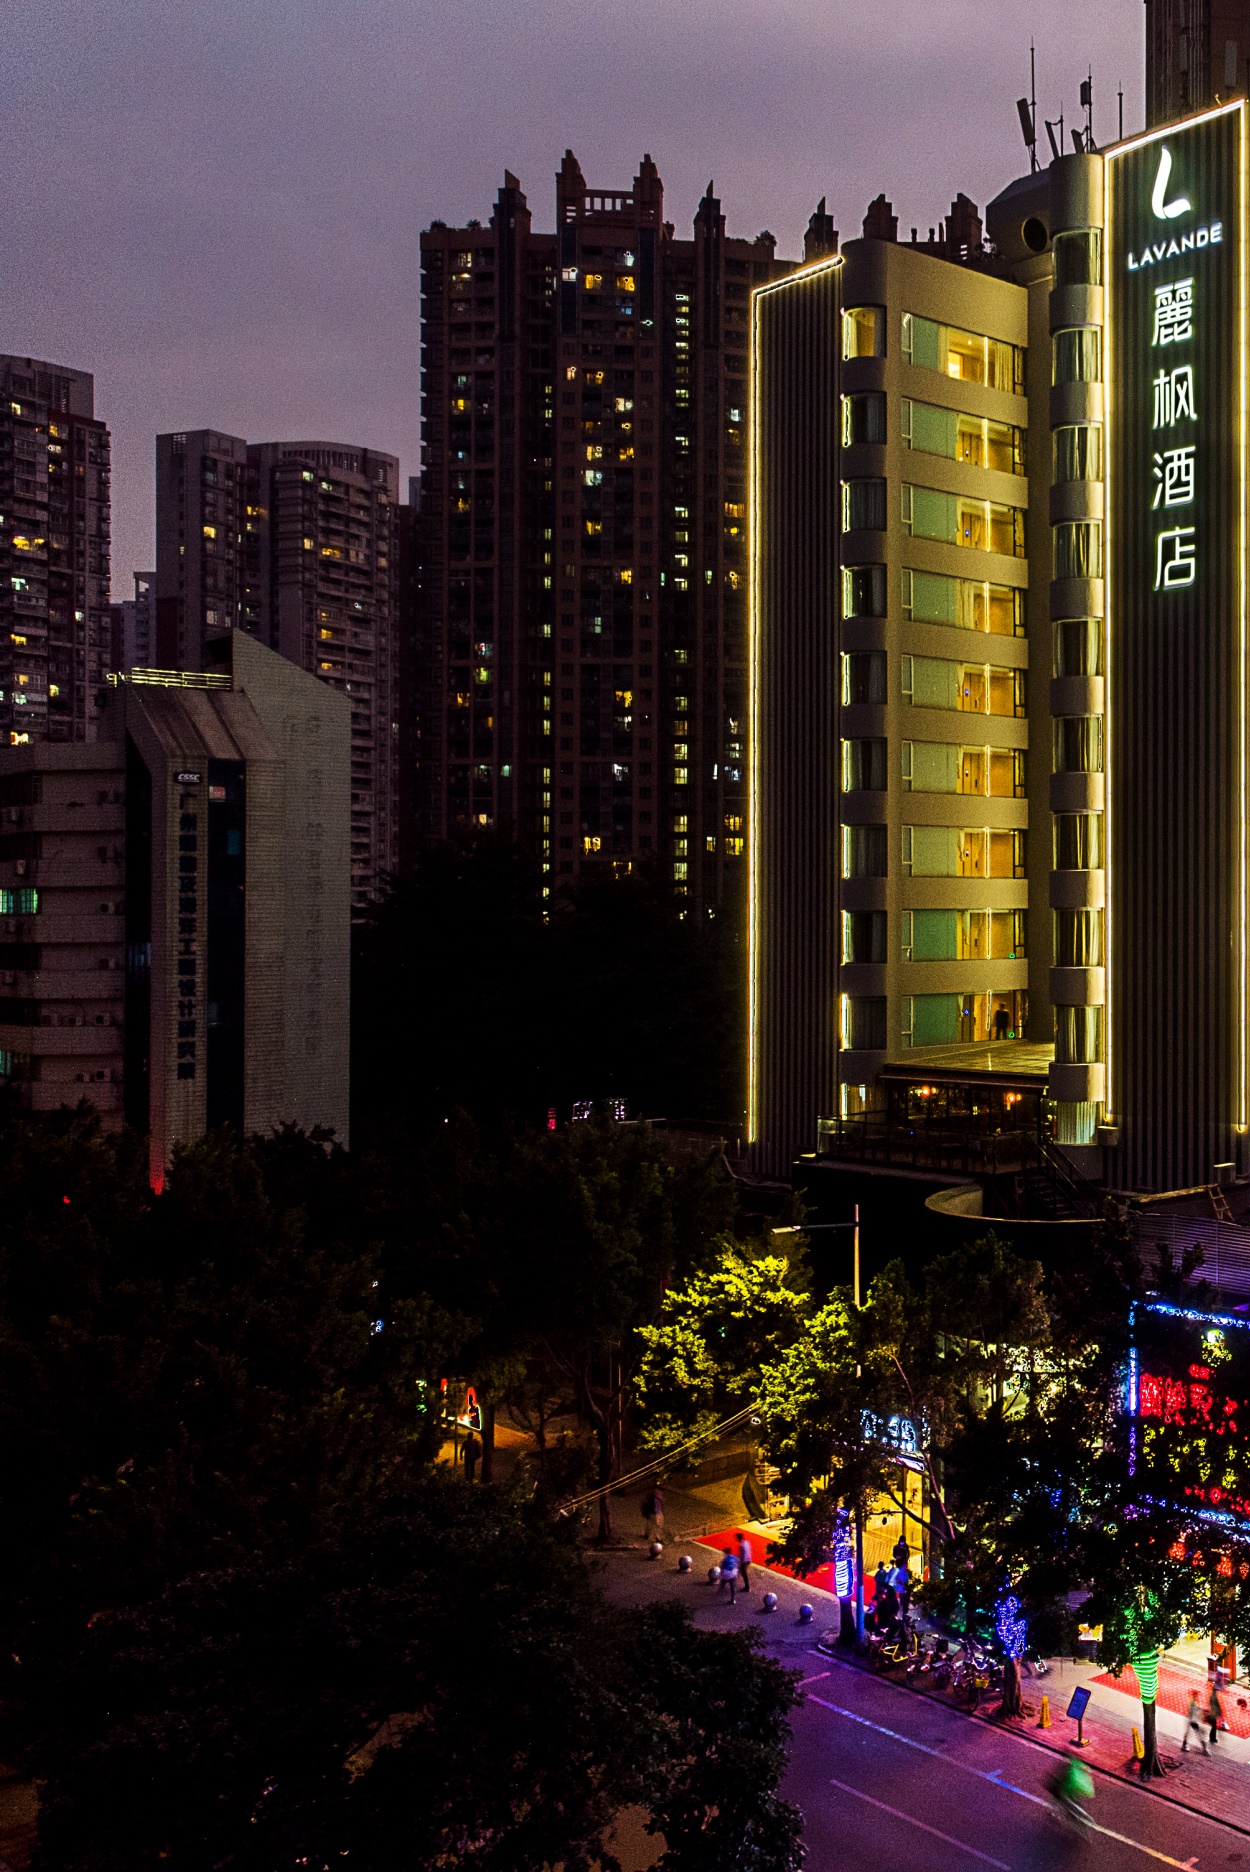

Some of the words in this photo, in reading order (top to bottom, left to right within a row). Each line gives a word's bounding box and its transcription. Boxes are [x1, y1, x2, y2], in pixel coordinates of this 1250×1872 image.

[1127, 220, 1223, 272] LAVANDE
[1151, 276, 1198, 592] 麗枫酒店
